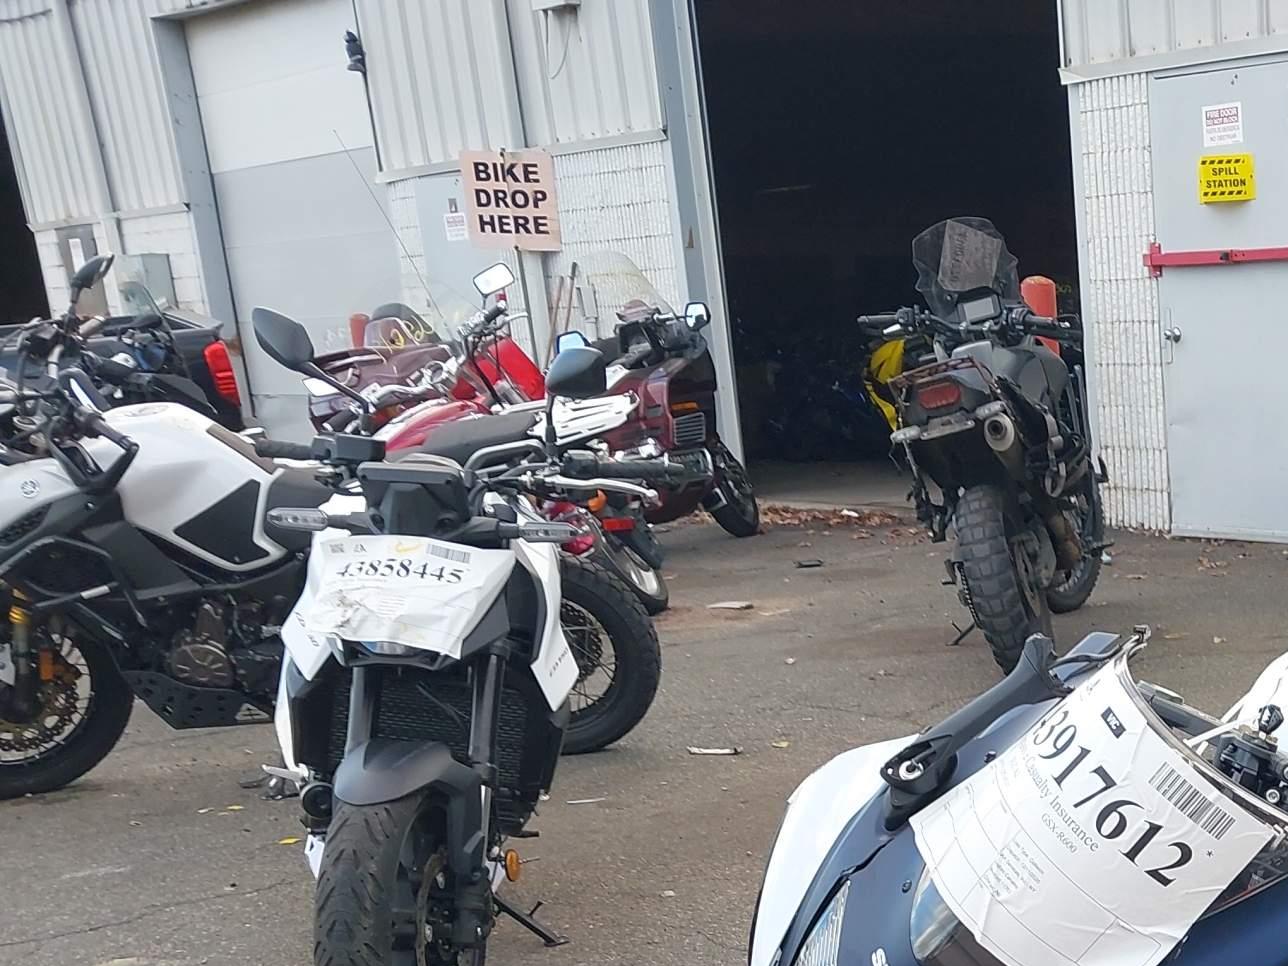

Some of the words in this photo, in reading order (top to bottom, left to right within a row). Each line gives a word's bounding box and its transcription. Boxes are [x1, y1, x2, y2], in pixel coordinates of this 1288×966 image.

[1220, 107, 1237, 117] DOOR
[473, 161, 540, 183] BIKE
[1211, 167, 1239, 176] SPILL
[1206, 178, 1246, 188] STATION
[474, 188, 547, 208] DROP
[478, 213, 550, 234] HERE
[1025, 756, 1052, 798] Casualty
[1049, 795, 1099, 852] Insurance
[1041, 812, 1078, 854] GSX-R600
